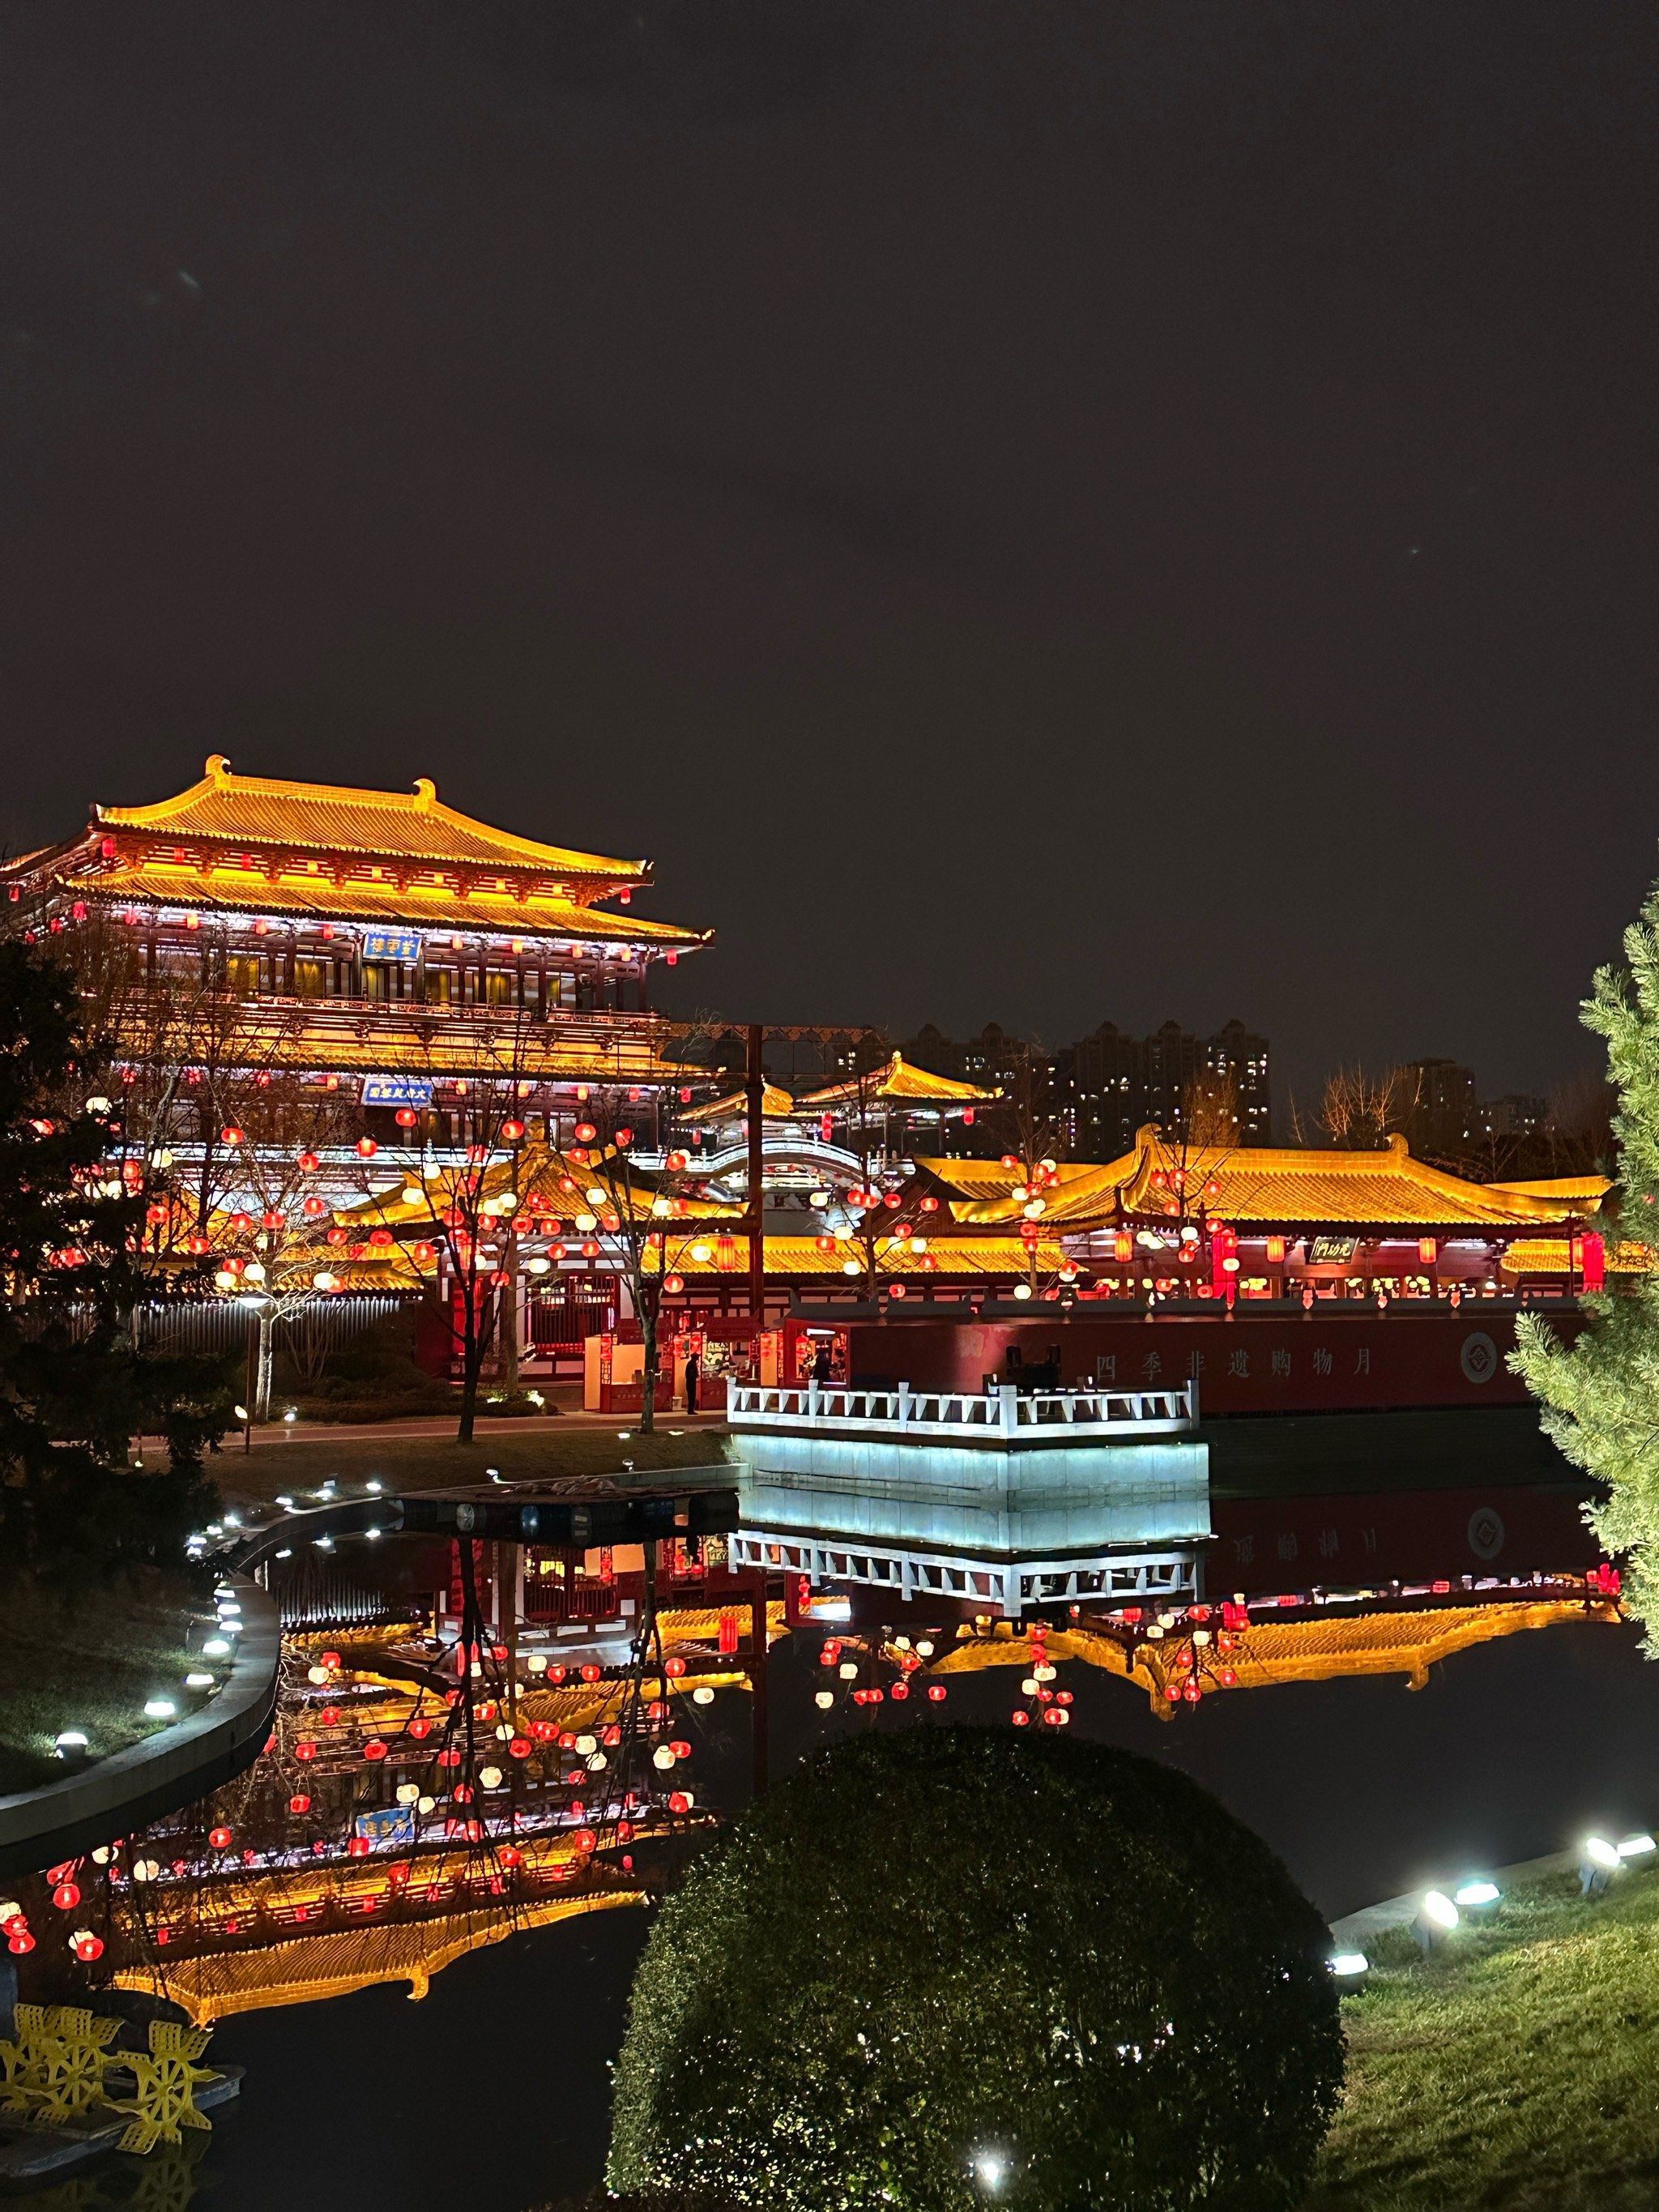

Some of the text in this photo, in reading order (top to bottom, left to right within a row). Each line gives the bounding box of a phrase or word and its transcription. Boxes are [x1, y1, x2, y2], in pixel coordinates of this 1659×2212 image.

[1097, 1348, 1371, 1381] 四季非遗购物月
